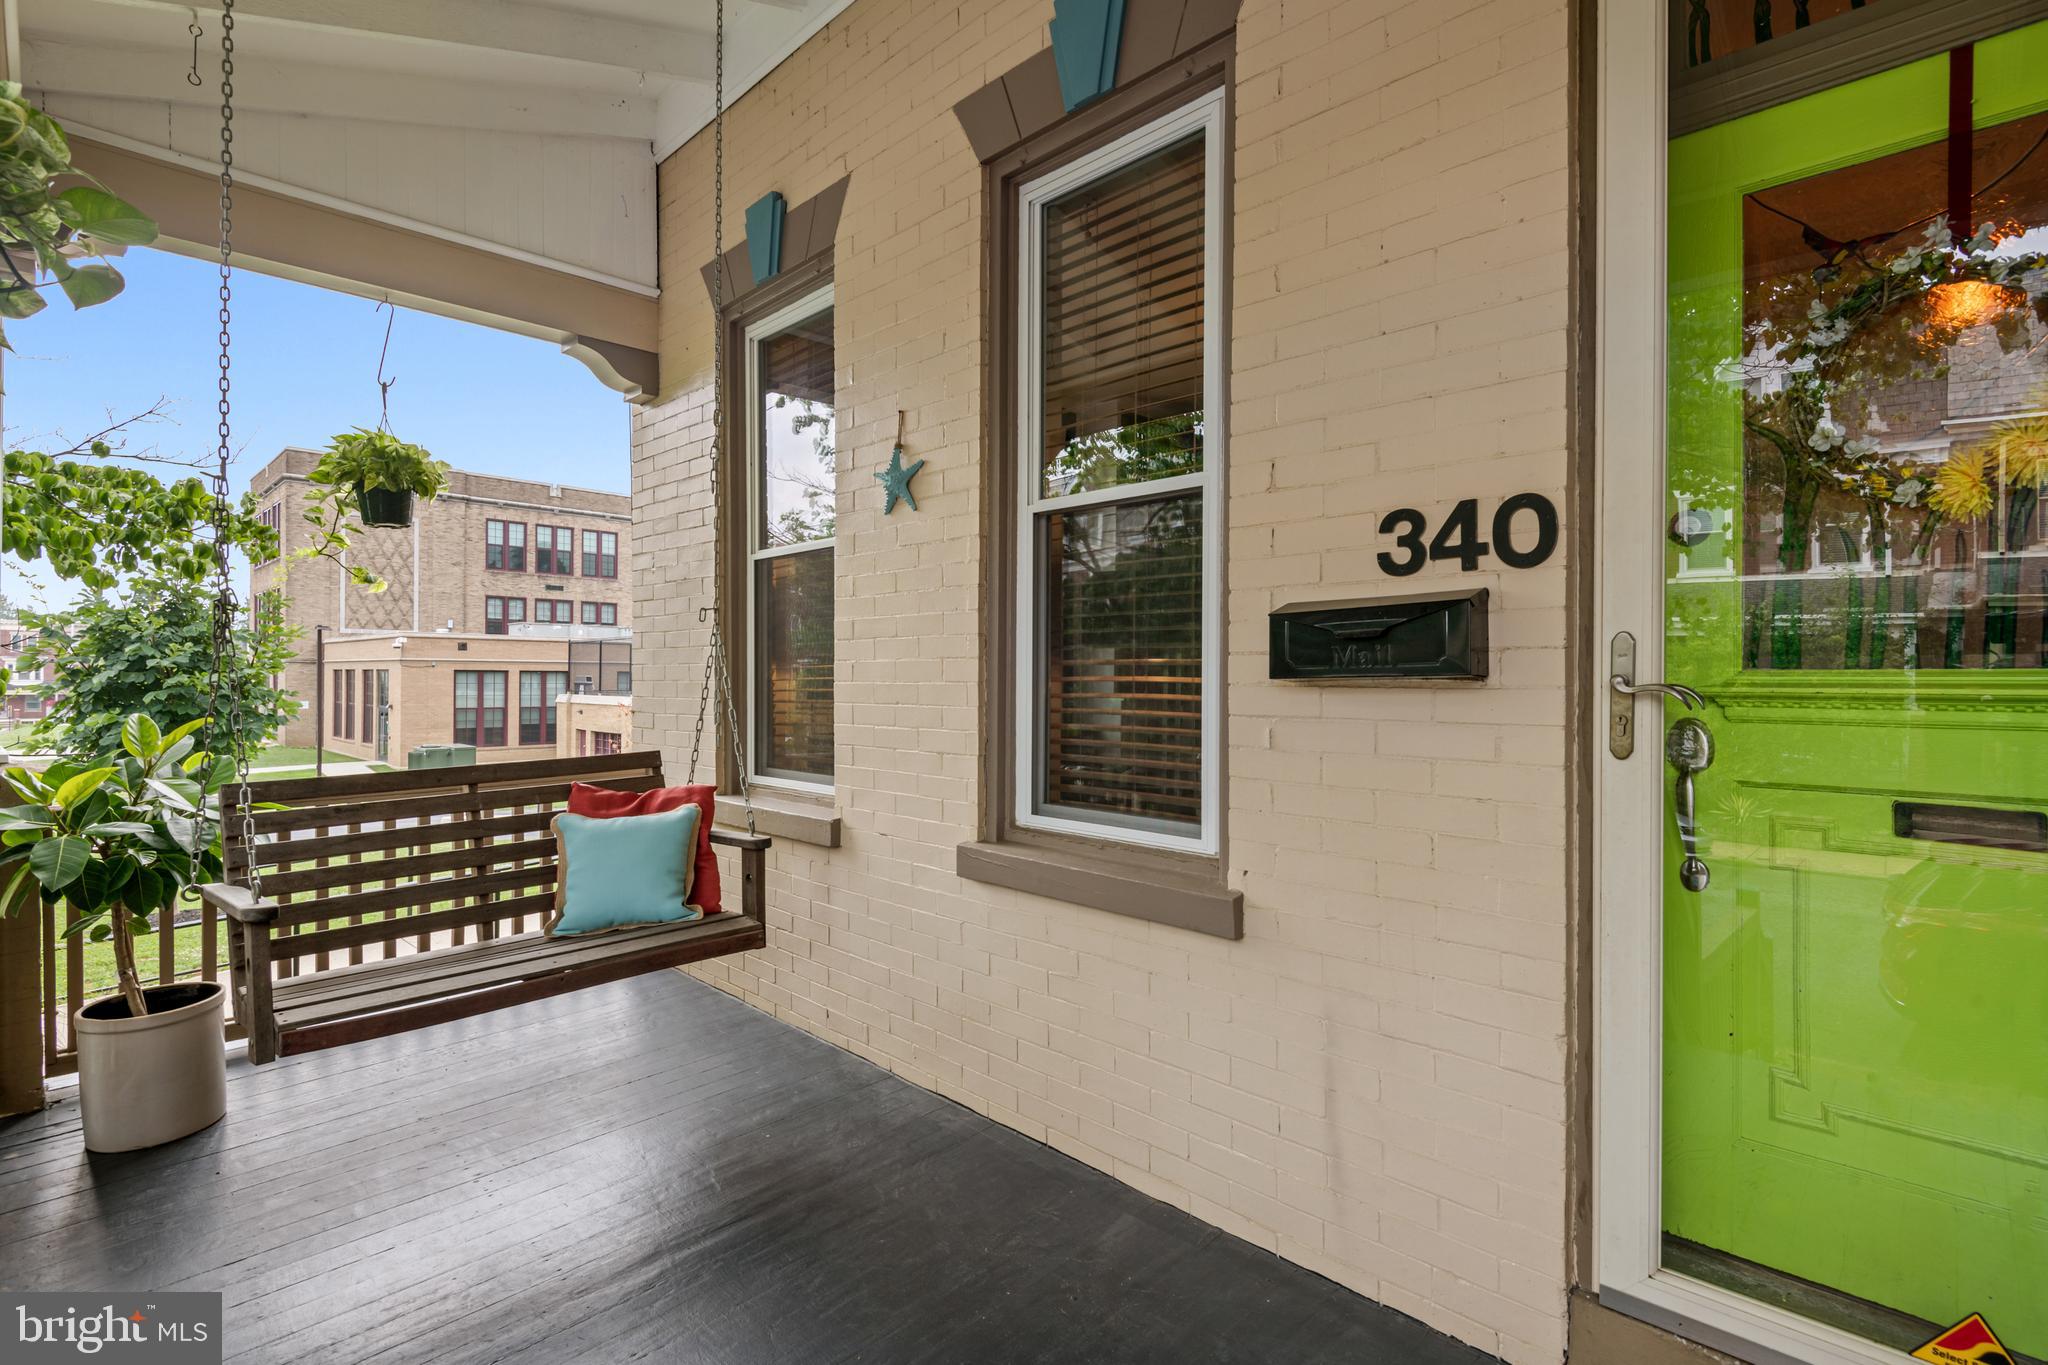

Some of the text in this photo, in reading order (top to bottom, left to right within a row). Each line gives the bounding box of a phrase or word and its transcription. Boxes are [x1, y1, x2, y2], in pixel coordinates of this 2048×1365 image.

[1376, 492, 1559, 577] 340
[1330, 644, 1393, 669] Mail
[1931, 1347, 1969, 1365] Select
